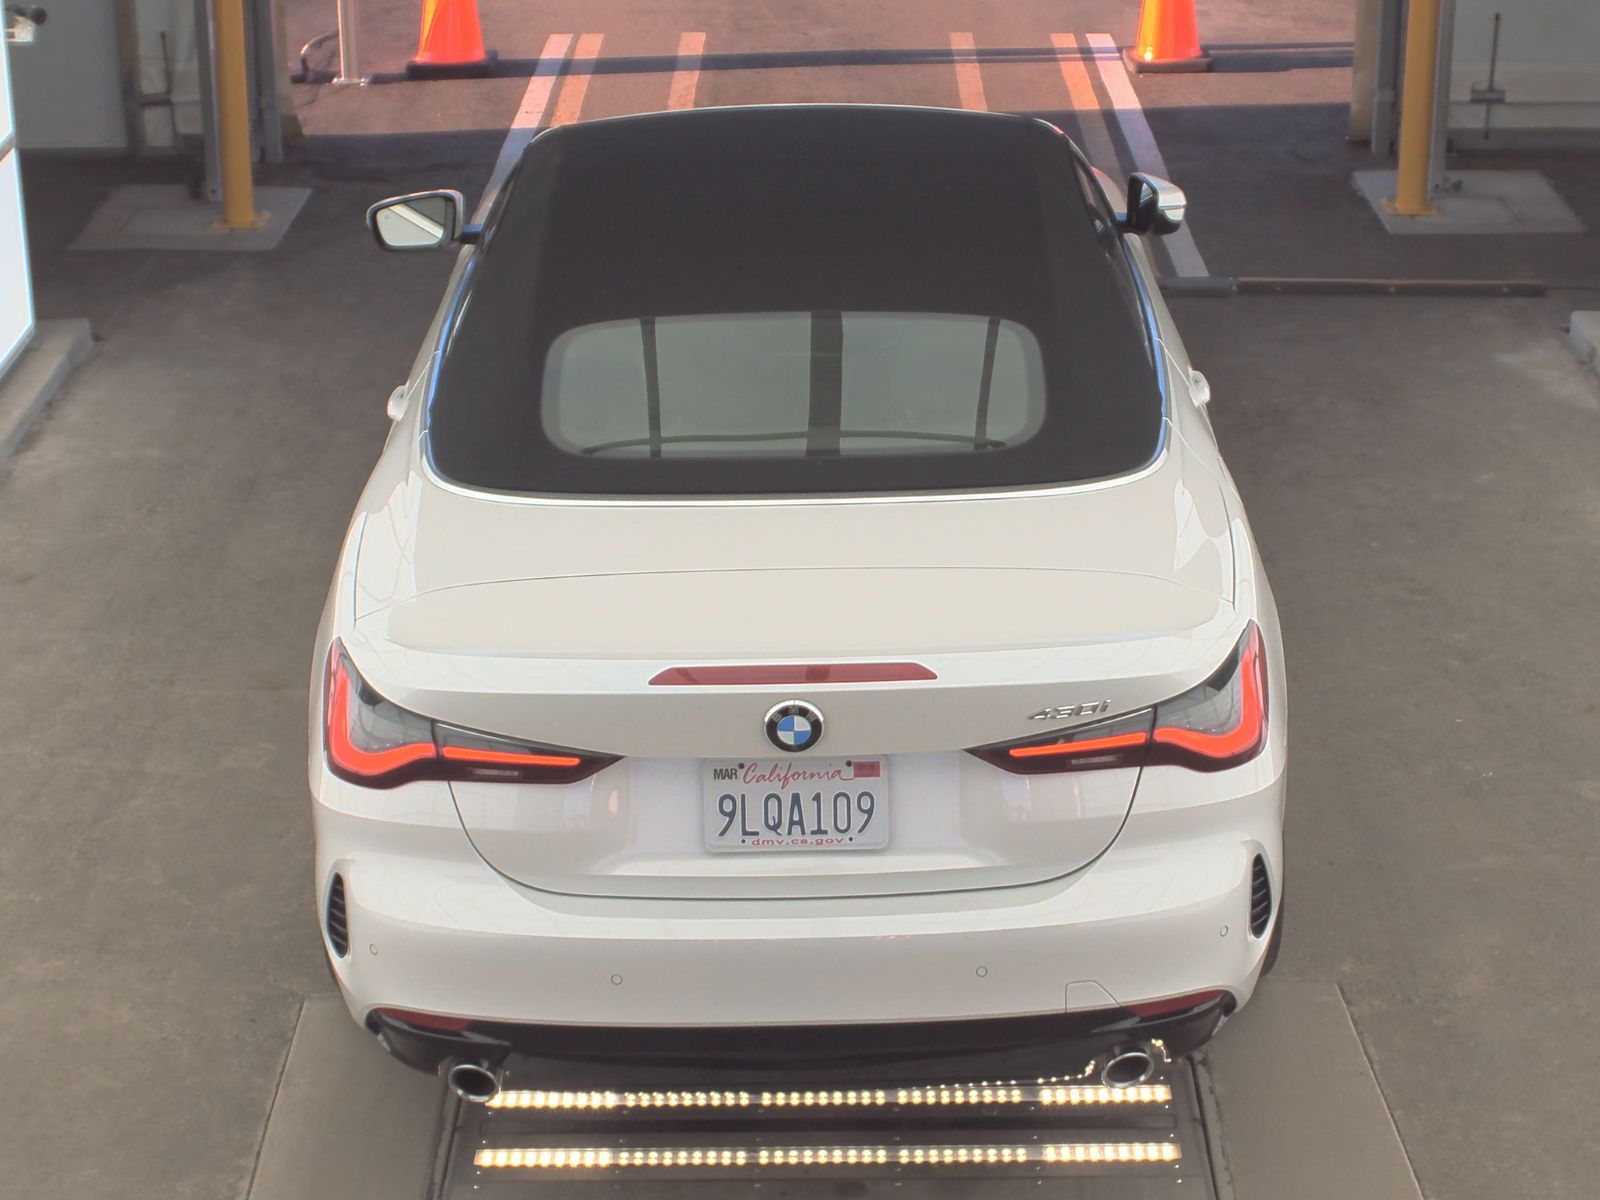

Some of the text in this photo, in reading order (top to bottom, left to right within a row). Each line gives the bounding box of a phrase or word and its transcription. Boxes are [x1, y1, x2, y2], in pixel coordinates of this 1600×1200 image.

[1027, 699, 1112, 720] 430i
[713, 768, 738, 780] MAR
[743, 762, 855, 790] California
[718, 791, 875, 837] 9LQA109
[752, 837, 844, 846] dmv.ca.gov
